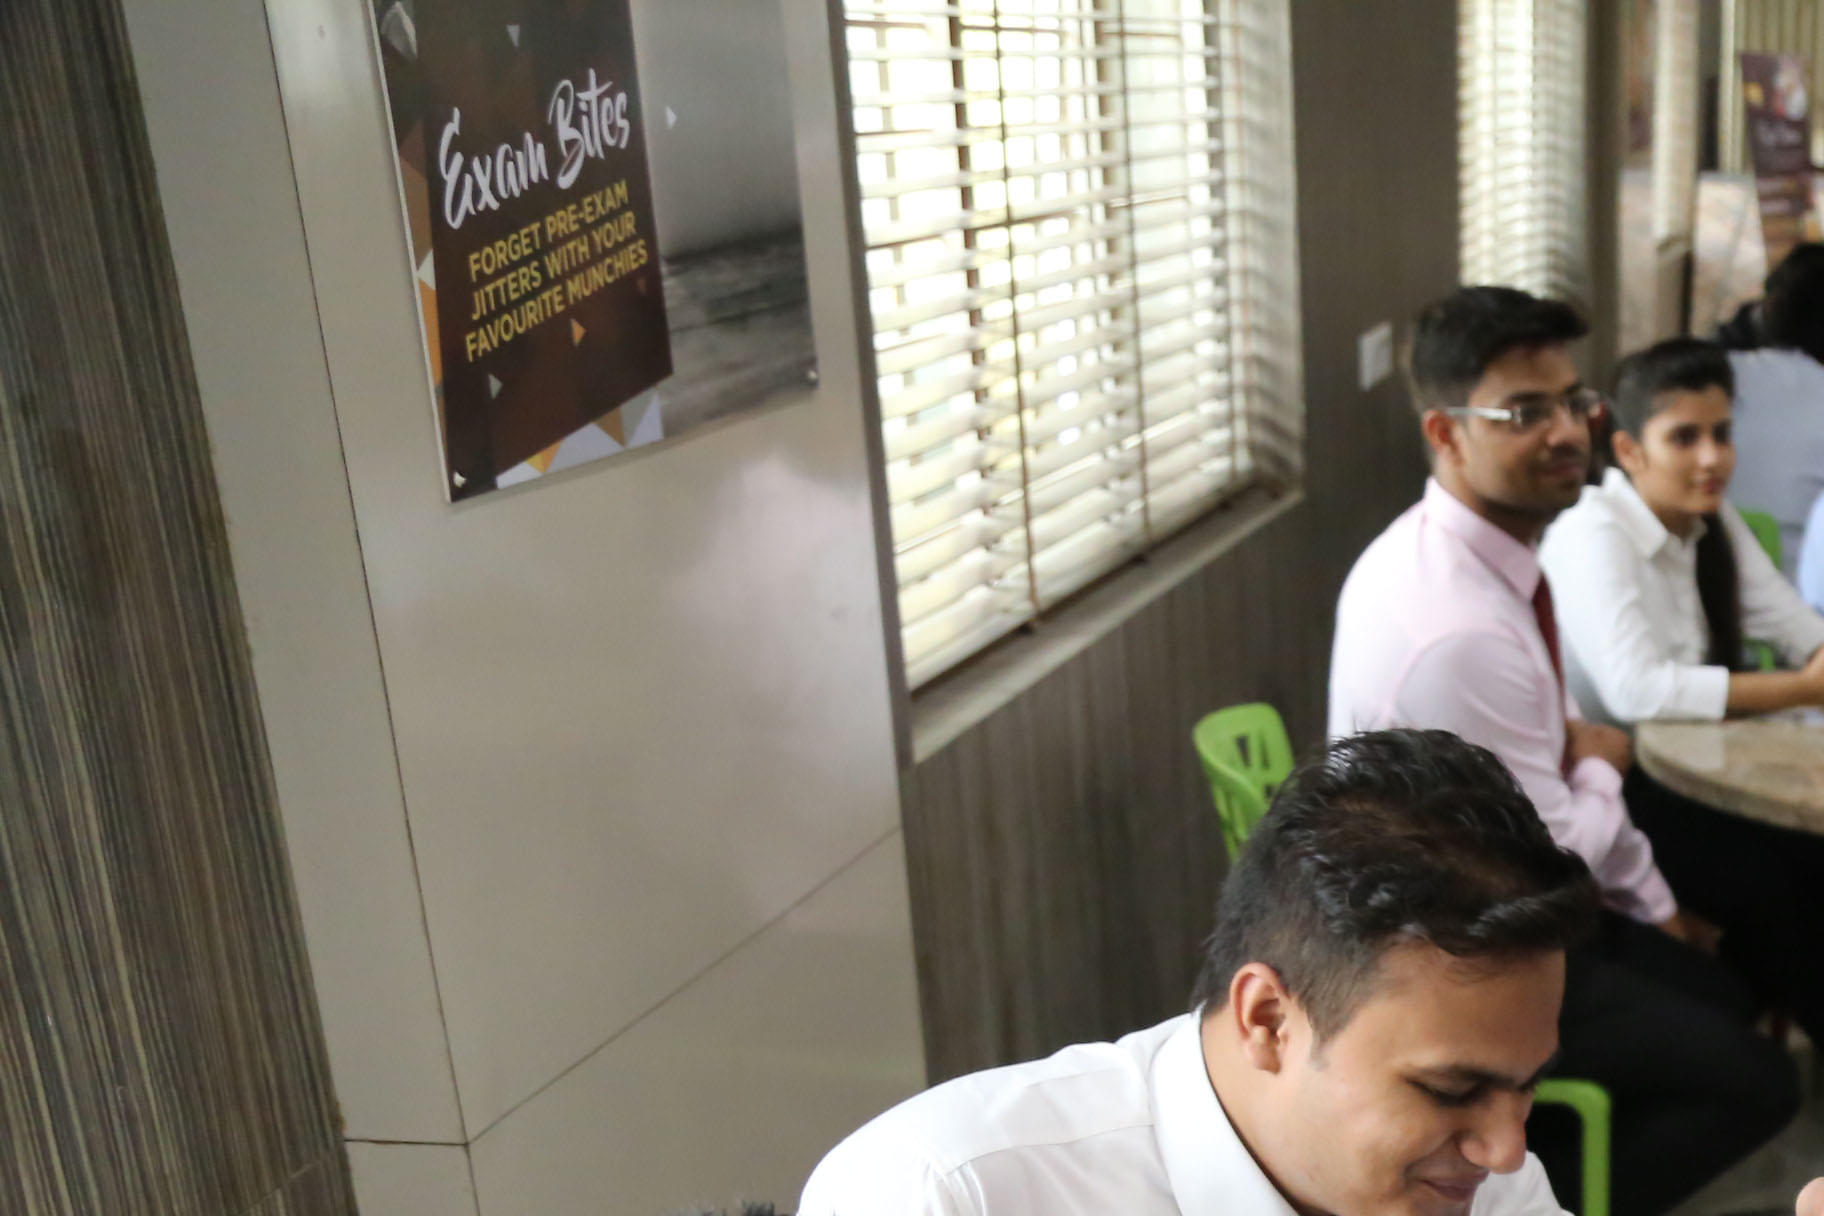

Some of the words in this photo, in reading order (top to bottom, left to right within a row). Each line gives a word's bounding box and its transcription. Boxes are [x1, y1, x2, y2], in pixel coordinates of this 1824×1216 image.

[440, 107, 548, 230] Exam
[548, 68, 630, 189] Bites
[469, 222, 541, 282] FORGET
[545, 180, 629, 242] PRE-EXAM
[472, 260, 542, 321] JITTERS
[544, 235, 590, 279] WITH
[592, 211, 636, 253] YOUR
[465, 285, 565, 362] FAVOURITE
[566, 239, 648, 304] MUNCHIES
